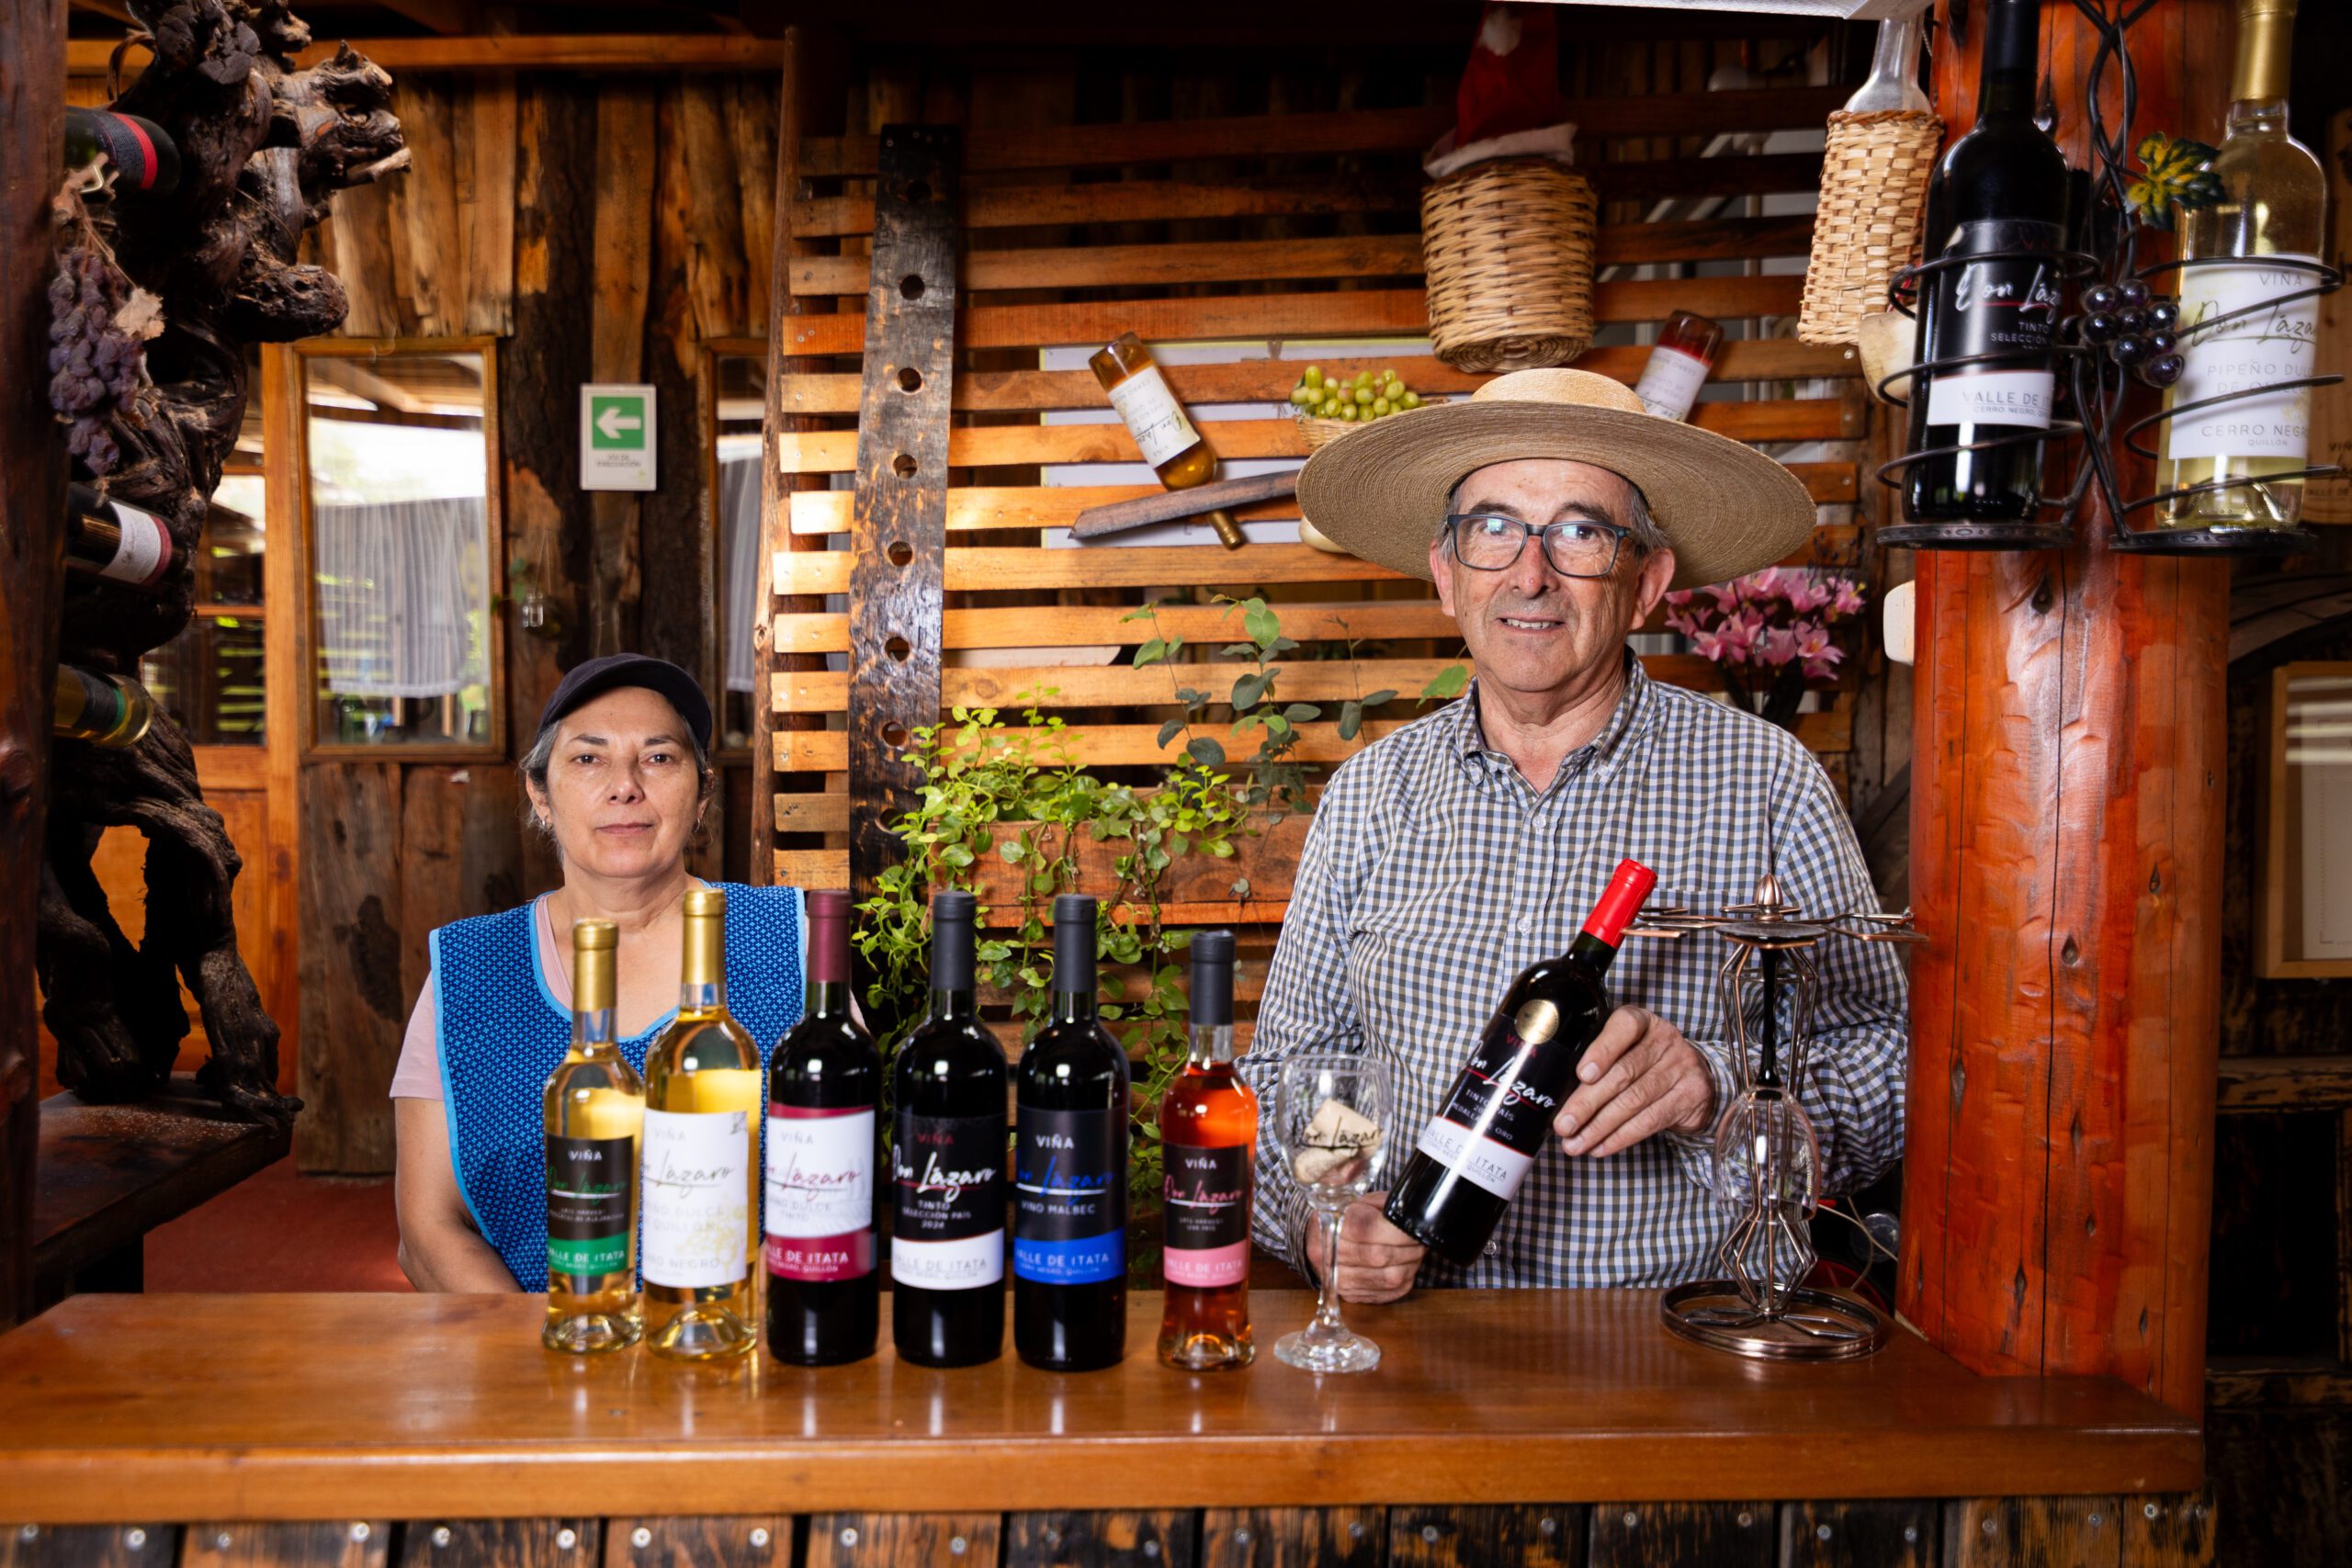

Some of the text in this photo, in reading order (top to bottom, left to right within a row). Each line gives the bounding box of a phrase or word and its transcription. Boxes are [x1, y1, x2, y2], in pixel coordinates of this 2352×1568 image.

[2258, 271, 2302, 287] VIÑA
[1955, 263, 2014, 312] Don
[2018, 321, 2050, 334] TINTO
[2191, 299, 2248, 347] Don
[2207, 359, 2277, 377] PIPEÑO
[1962, 390, 2017, 404] VALLE
[2022, 392, 2040, 406] DE
[2201, 424, 2265, 437] CERRO
[1498, 1108, 1515, 1122] AÍS
[782, 1131, 814, 1144] VIÑA
[1035, 1133, 1075, 1149] VIÑA
[1495, 1126, 1514, 1141] ORO
[568, 1148, 603, 1161] VIÑA
[1185, 1156, 1217, 1169] VIÑA
[1474, 1156, 1508, 1180] ITATA
[782, 1151, 864, 1203] Lázaro
[916, 1151, 998, 1204] Lázaro
[917, 1199, 951, 1212] TINTO
[1022, 1200, 1096, 1215] VINO MALBEC
[573, 1252, 590, 1263] DE
[594, 1250, 625, 1262] ITATA
[786, 1249, 803, 1264] DE
[807, 1250, 849, 1265] ITATA
[1047, 1254, 1066, 1268] DE
[1071, 1253, 1110, 1267] ITATA
[926, 1259, 944, 1272] DE
[950, 1258, 987, 1270] ITATA
[1195, 1262, 1211, 1273] DE
[1215, 1258, 1242, 1273] ITATA
